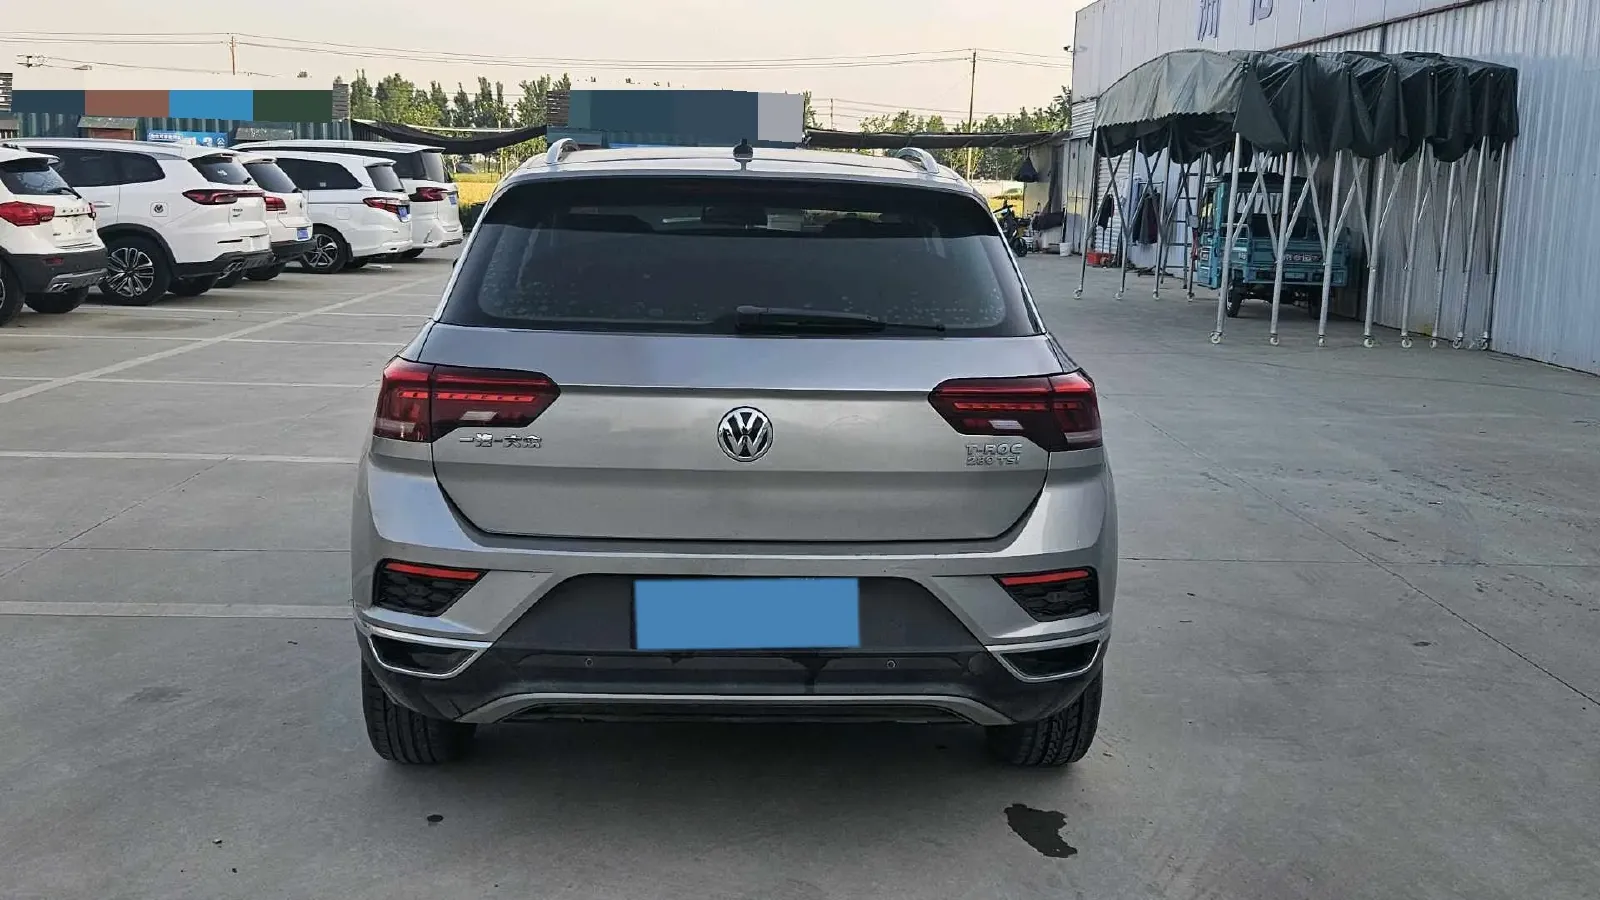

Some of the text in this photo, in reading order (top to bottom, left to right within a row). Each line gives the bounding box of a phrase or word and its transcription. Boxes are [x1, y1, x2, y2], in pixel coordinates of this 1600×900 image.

[965, 442, 1023, 455] T-ROC
[966, 455, 1020, 466] 280 TSI
